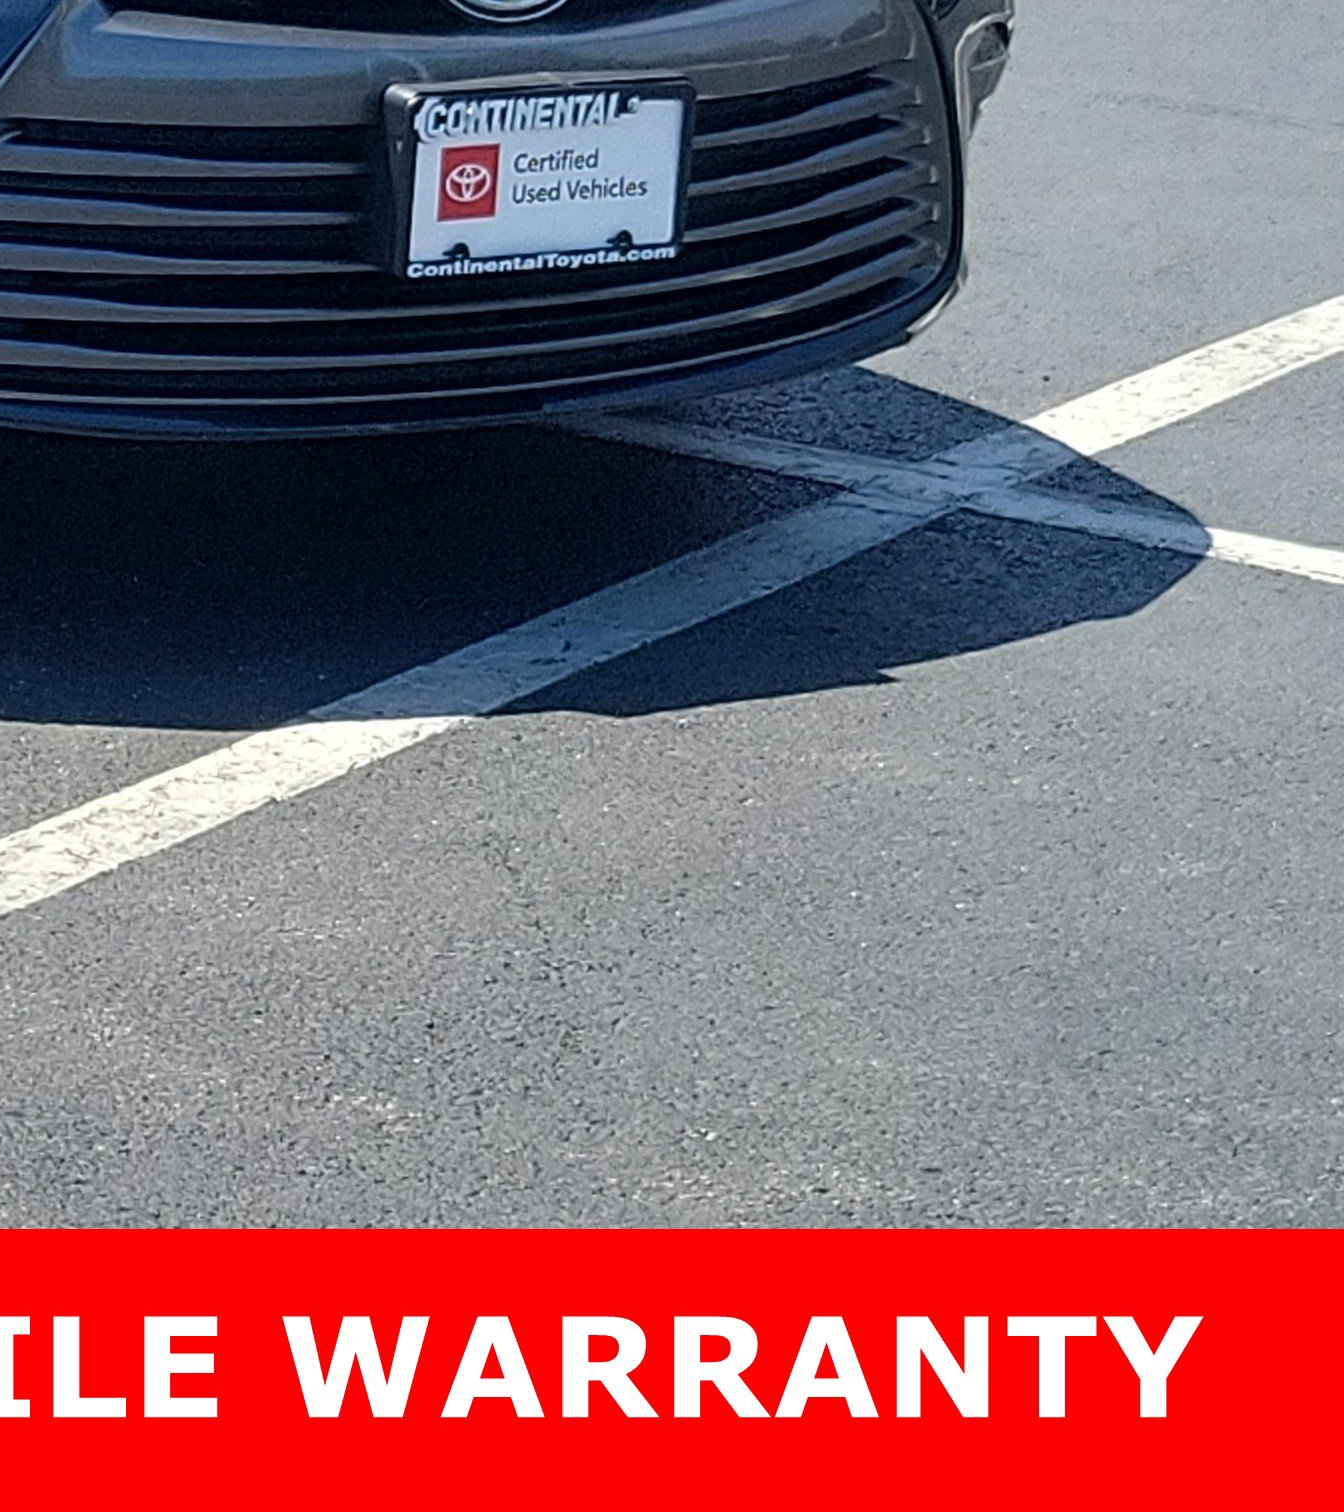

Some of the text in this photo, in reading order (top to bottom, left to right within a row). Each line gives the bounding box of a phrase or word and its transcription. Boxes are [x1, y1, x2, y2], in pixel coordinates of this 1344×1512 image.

[415, 91, 623, 140] CONTINENTAL
[513, 148, 599, 174] Certified
[512, 176, 649, 204] Used Vehicles
[407, 245, 675, 279] ContinentalToyota.com
